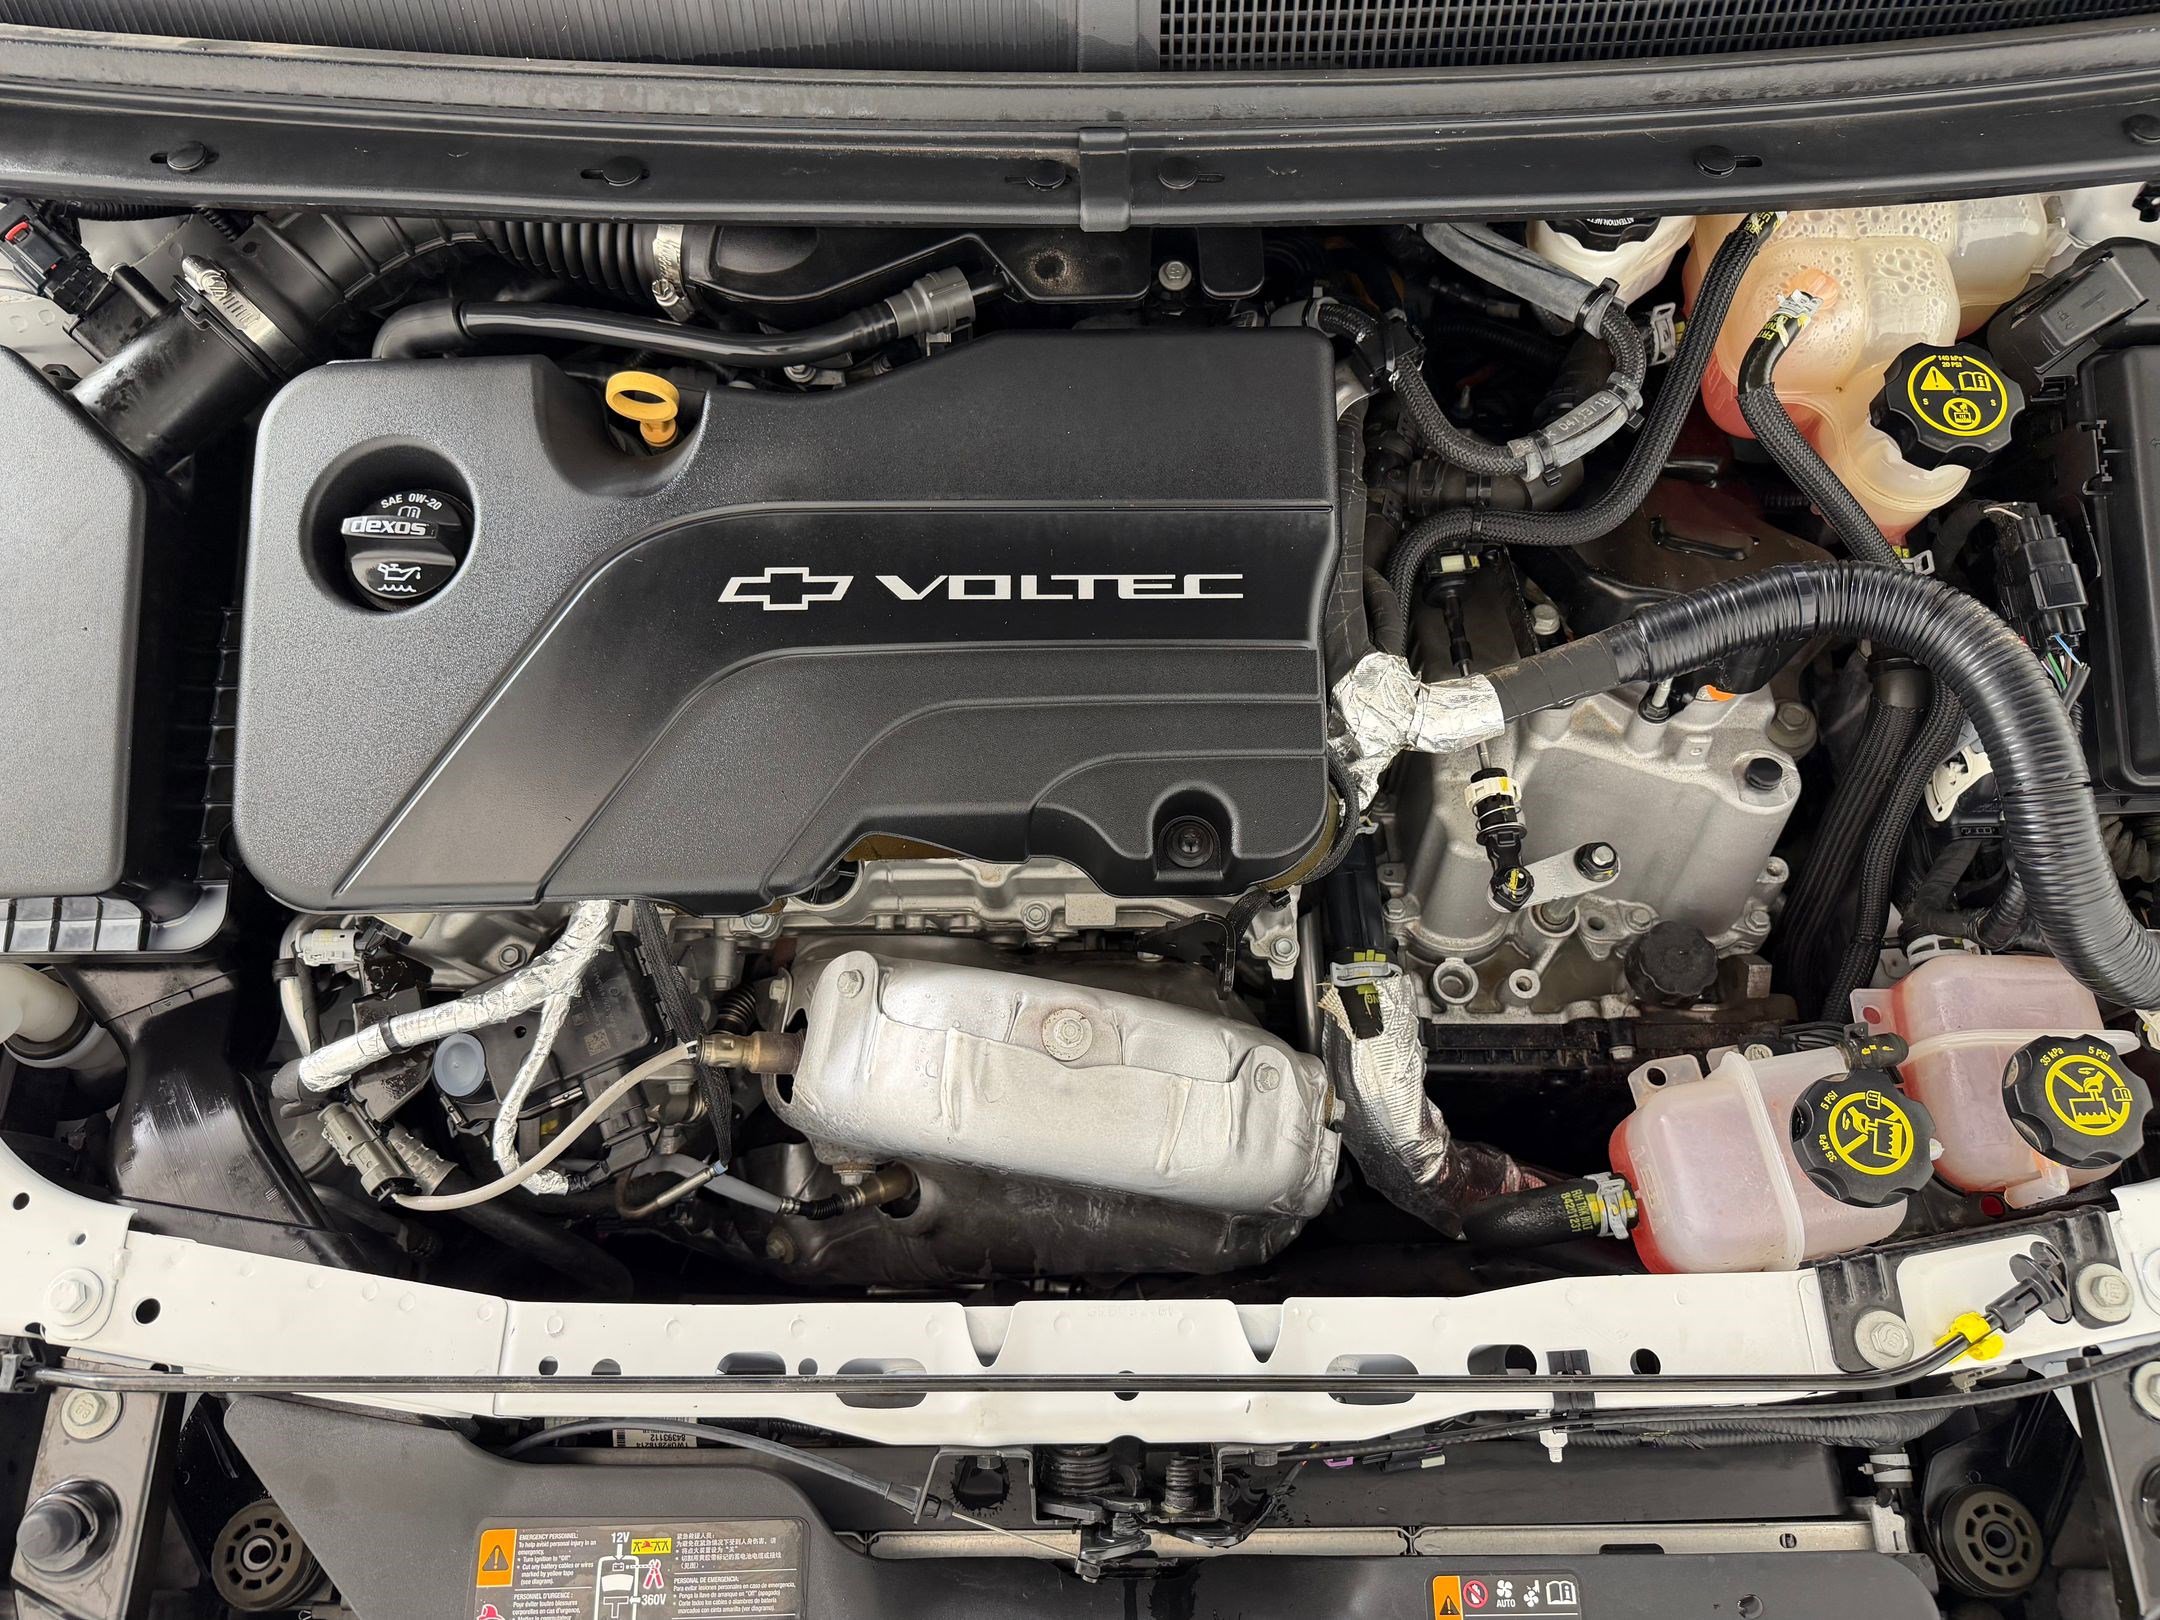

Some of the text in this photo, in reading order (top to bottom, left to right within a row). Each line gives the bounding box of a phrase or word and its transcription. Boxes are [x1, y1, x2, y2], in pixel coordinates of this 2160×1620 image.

[381, 493, 442, 511] SAE 0W-20
[350, 516, 426, 536] dexos
[875, 574, 1243, 599] VOLTEC
[2040, 1046, 2111, 1066] 35 kPa 5 PSI
[1825, 1090, 1838, 1104] PSI
[1818, 1134, 1830, 1151] kPa
[1825, 1151, 1837, 1163] 35
[1571, 1189, 1585, 1201] RH
[1561, 1192, 1582, 1232] 84201231
[611, 1532, 630, 1543] 12V
[641, 1594, 666, 1605] 360V
[1496, 1599, 1516, 1608] AUTO
